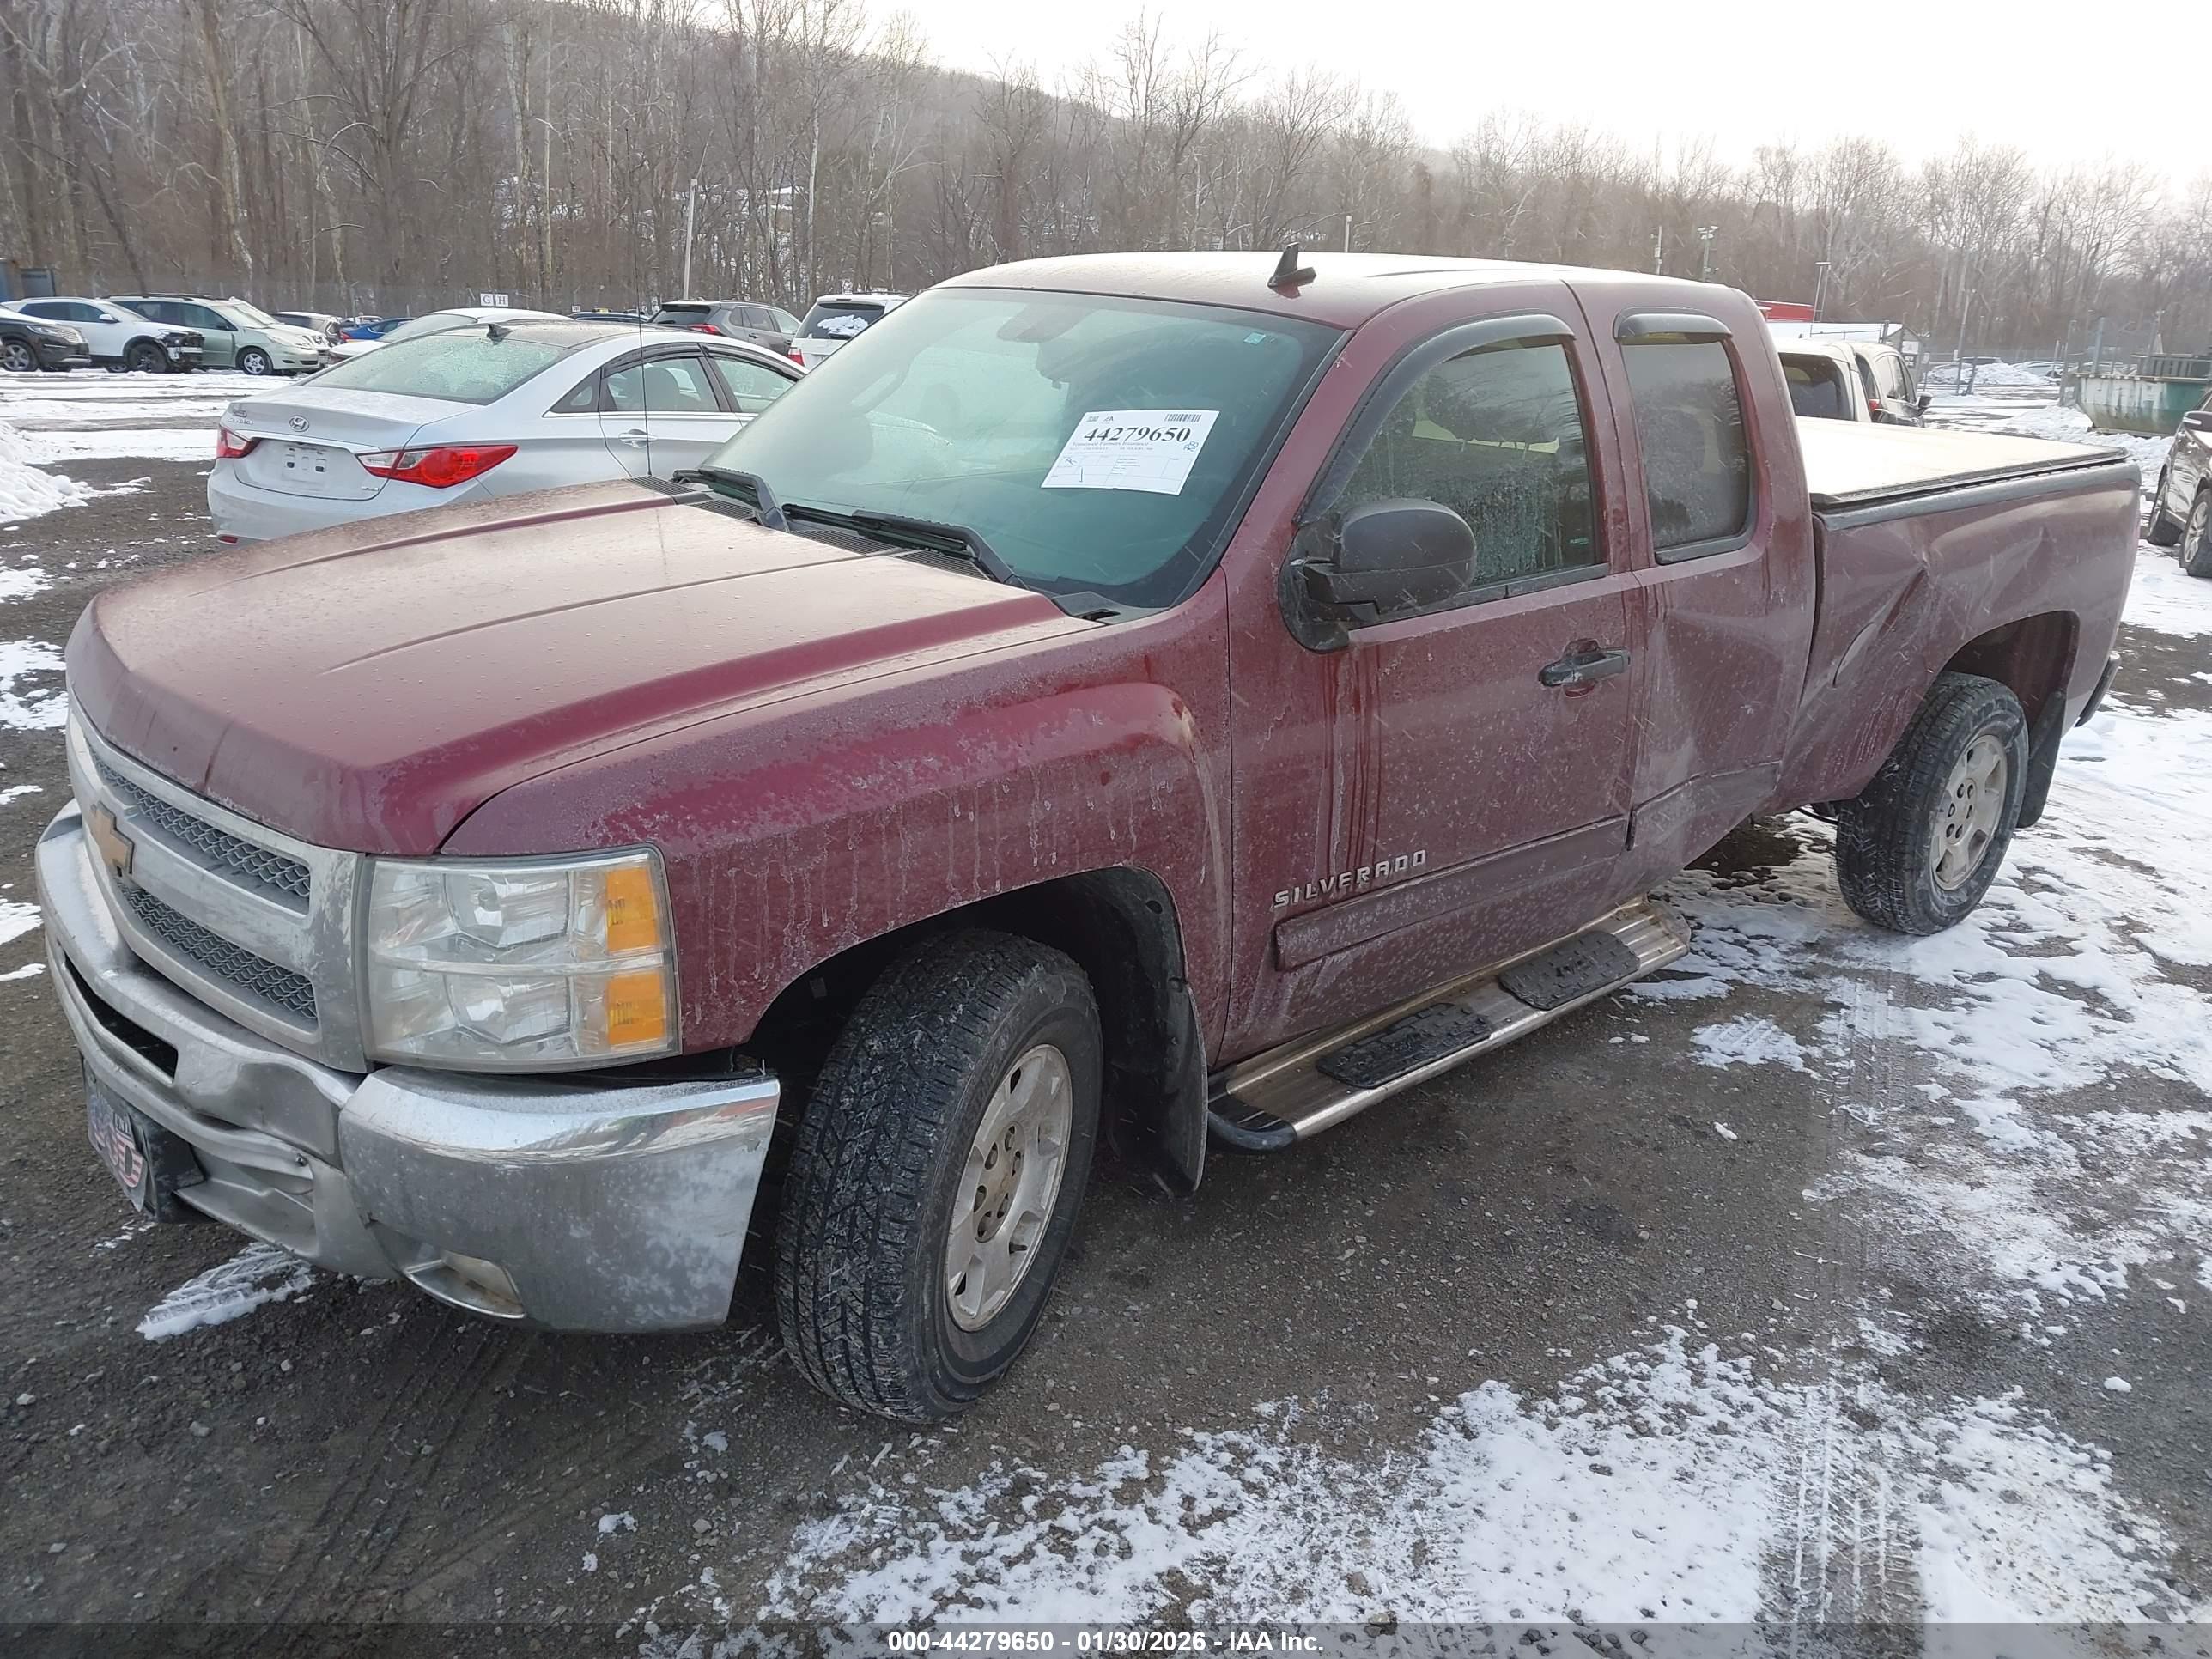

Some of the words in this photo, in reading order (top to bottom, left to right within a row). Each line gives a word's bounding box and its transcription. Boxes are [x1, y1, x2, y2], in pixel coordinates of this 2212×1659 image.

[483, 295, 491, 304] G
[498, 295, 506, 305] H
[1084, 427, 1191, 442] 44279650
[1271, 849, 1427, 908] SILVERADO
